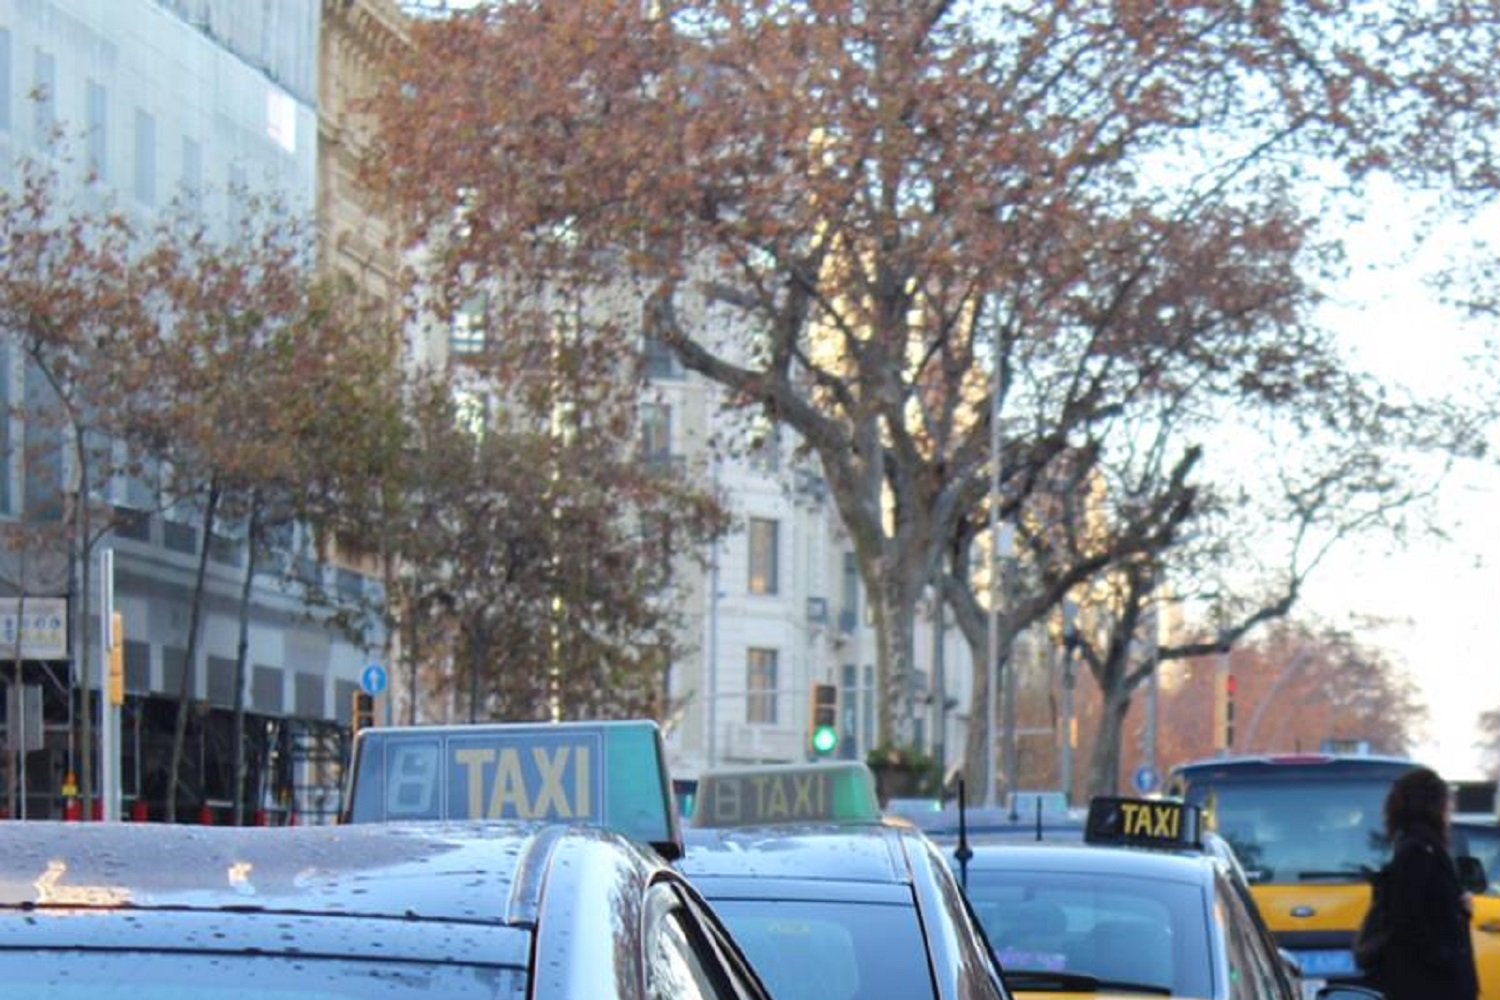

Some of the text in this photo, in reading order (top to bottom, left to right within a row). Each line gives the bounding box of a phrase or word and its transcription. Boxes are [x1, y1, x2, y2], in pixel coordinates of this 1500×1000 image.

[456, 746, 590, 820] TAXI
[752, 774, 826, 817] TAXI
[1121, 803, 1181, 838] TAXI
